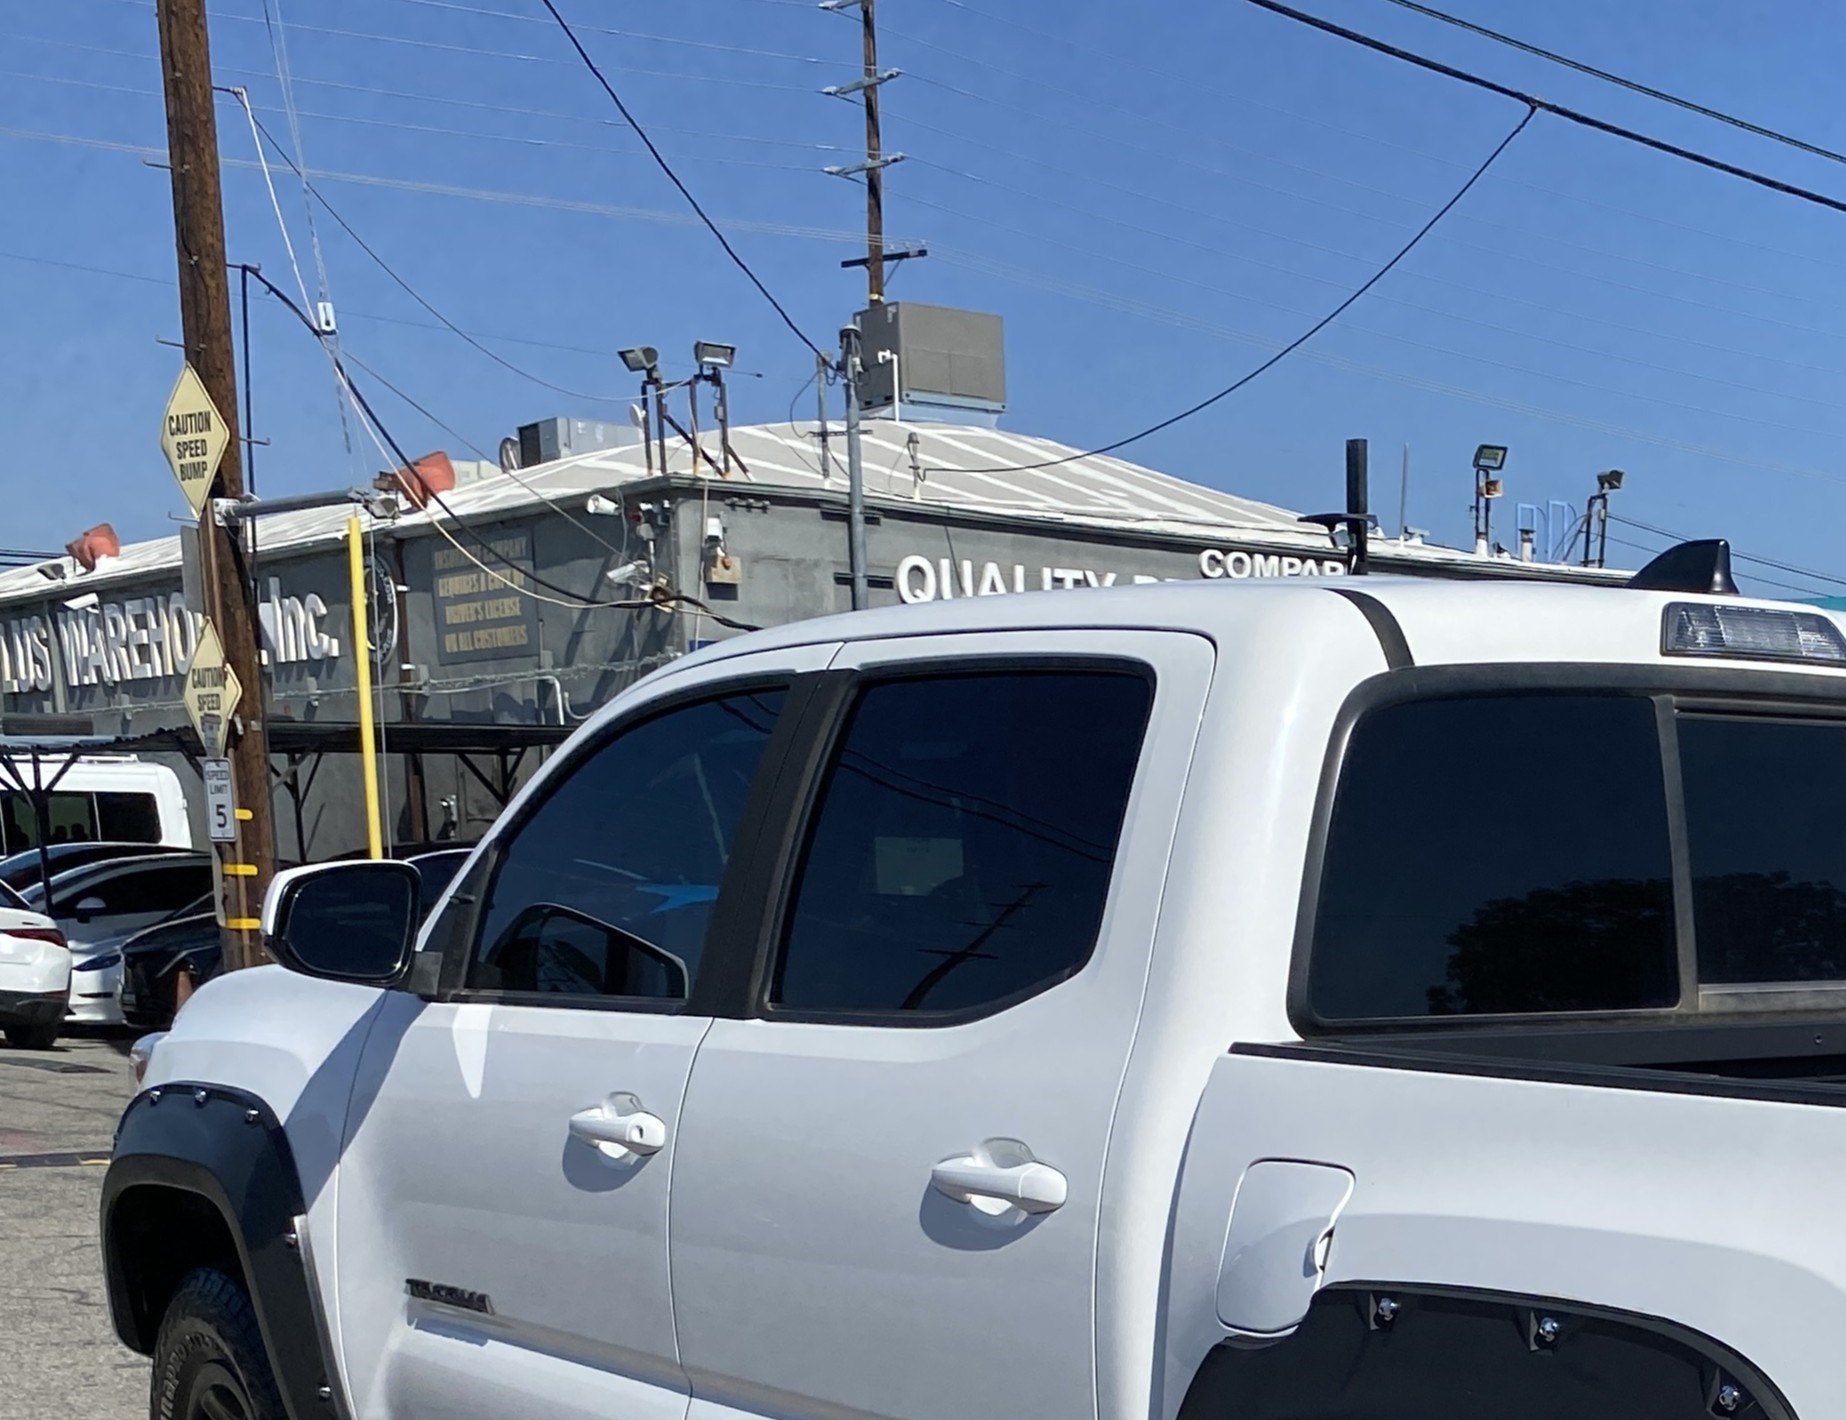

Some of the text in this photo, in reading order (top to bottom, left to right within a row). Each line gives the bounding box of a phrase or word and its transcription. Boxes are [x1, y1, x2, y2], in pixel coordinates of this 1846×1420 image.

[168, 410, 212, 436] CAUTION
[176, 439, 208, 460] SPEED
[179, 461, 208, 481] BUMP
[1199, 549, 1357, 577] COMPAR
[57, 591, 268, 687] WAREHO
[192, 667, 227, 690] CAUTION
[197, 693, 221, 711] SPEED
[206, 770, 230, 781] SPEED
[209, 784, 228, 795] LIMIT
[215, 804, 227, 828] 5
